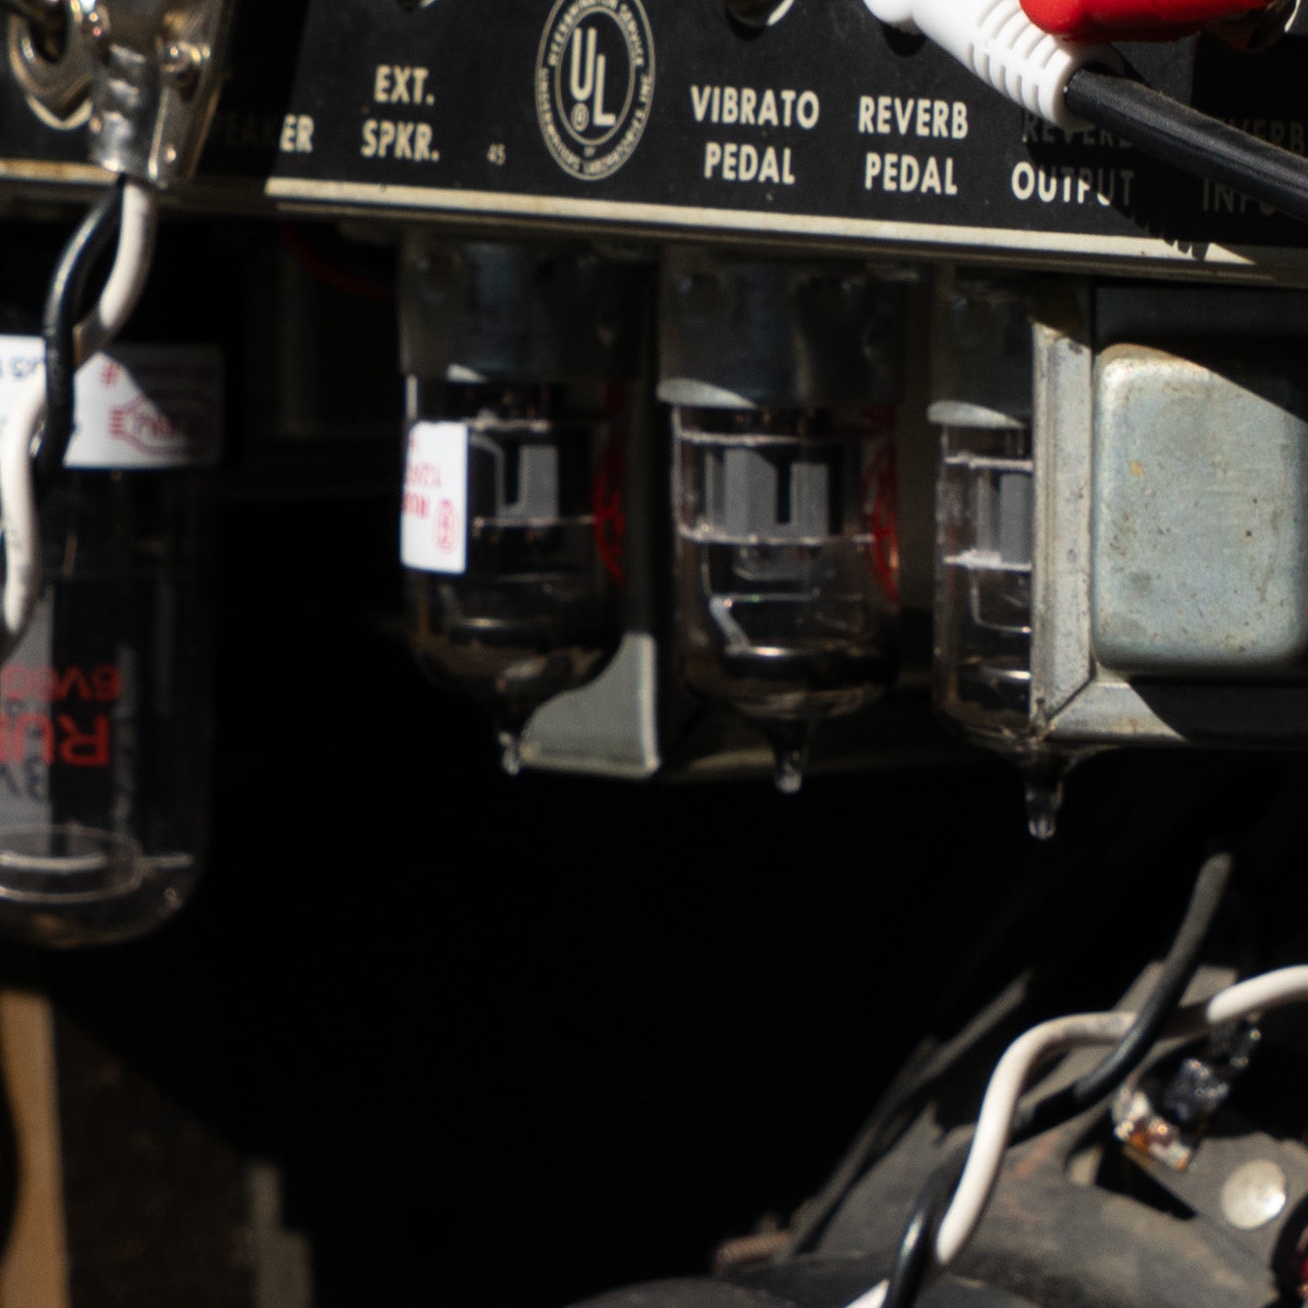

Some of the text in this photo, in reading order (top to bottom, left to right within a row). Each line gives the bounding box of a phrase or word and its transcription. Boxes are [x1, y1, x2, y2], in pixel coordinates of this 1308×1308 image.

[372, 63, 436, 107] EXT.
[568, 26, 617, 128] UL
[690, 84, 820, 129] VIBRATO
[858, 95, 968, 140] REVERB
[359, 118, 441, 163] SPKR.
[704, 141, 796, 185] PEDAL
[864, 150, 958, 196] PEDAL
[1010, 160, 1135, 206] OUTPUT
